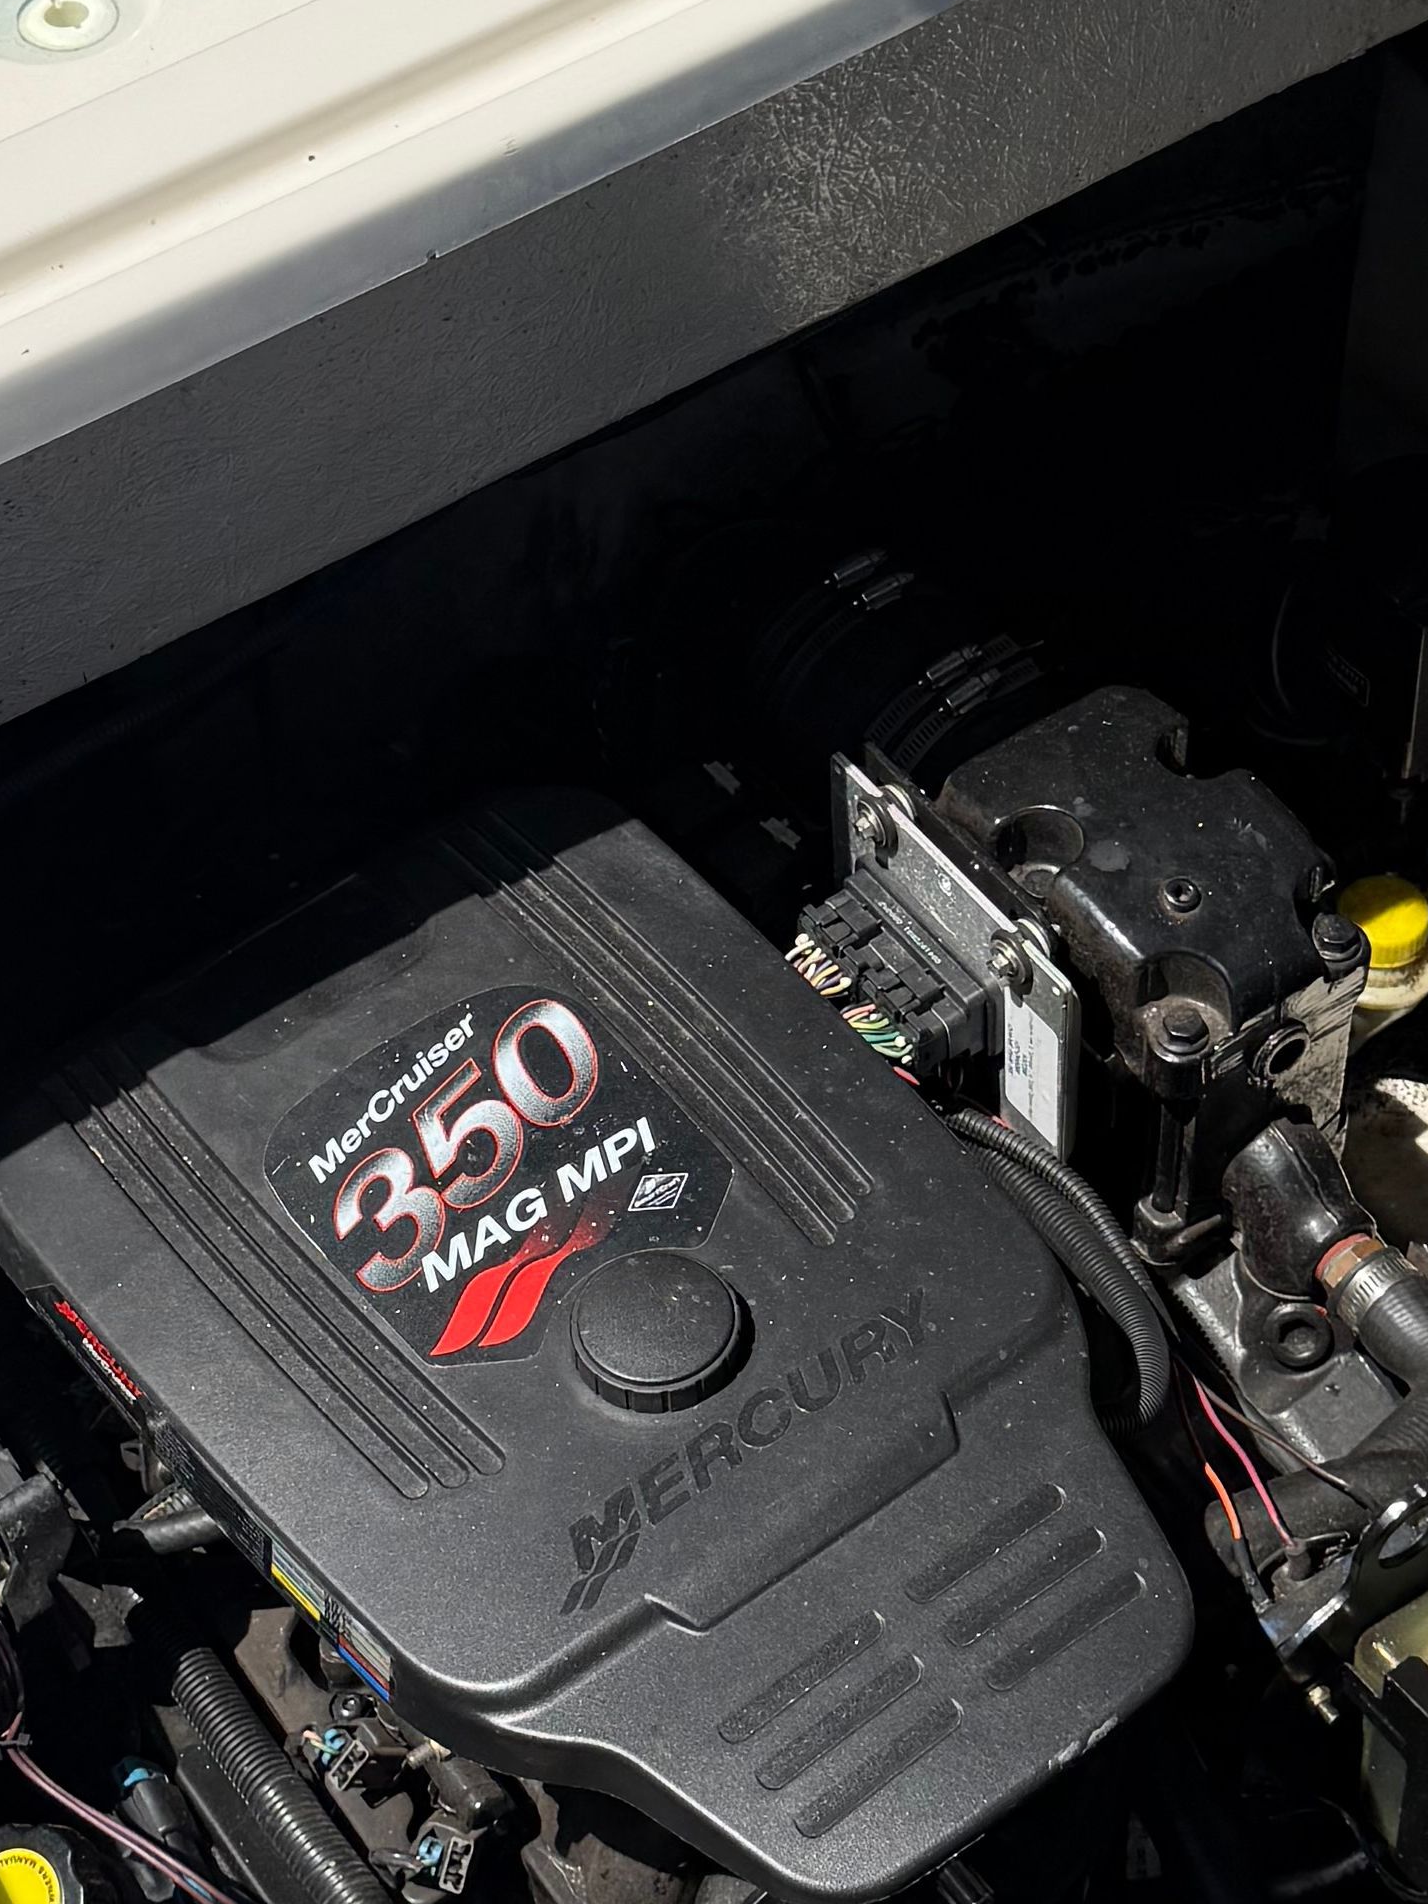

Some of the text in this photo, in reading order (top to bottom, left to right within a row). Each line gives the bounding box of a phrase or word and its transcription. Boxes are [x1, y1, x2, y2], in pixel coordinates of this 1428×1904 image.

[308, 1013, 475, 1183] MerCruiser
[333, 999, 598, 1291] 350
[421, 1117, 655, 1293] MAG MPI
[54, 1300, 142, 1399] MERCURY
[560, 1287, 925, 1614] MERCURY
